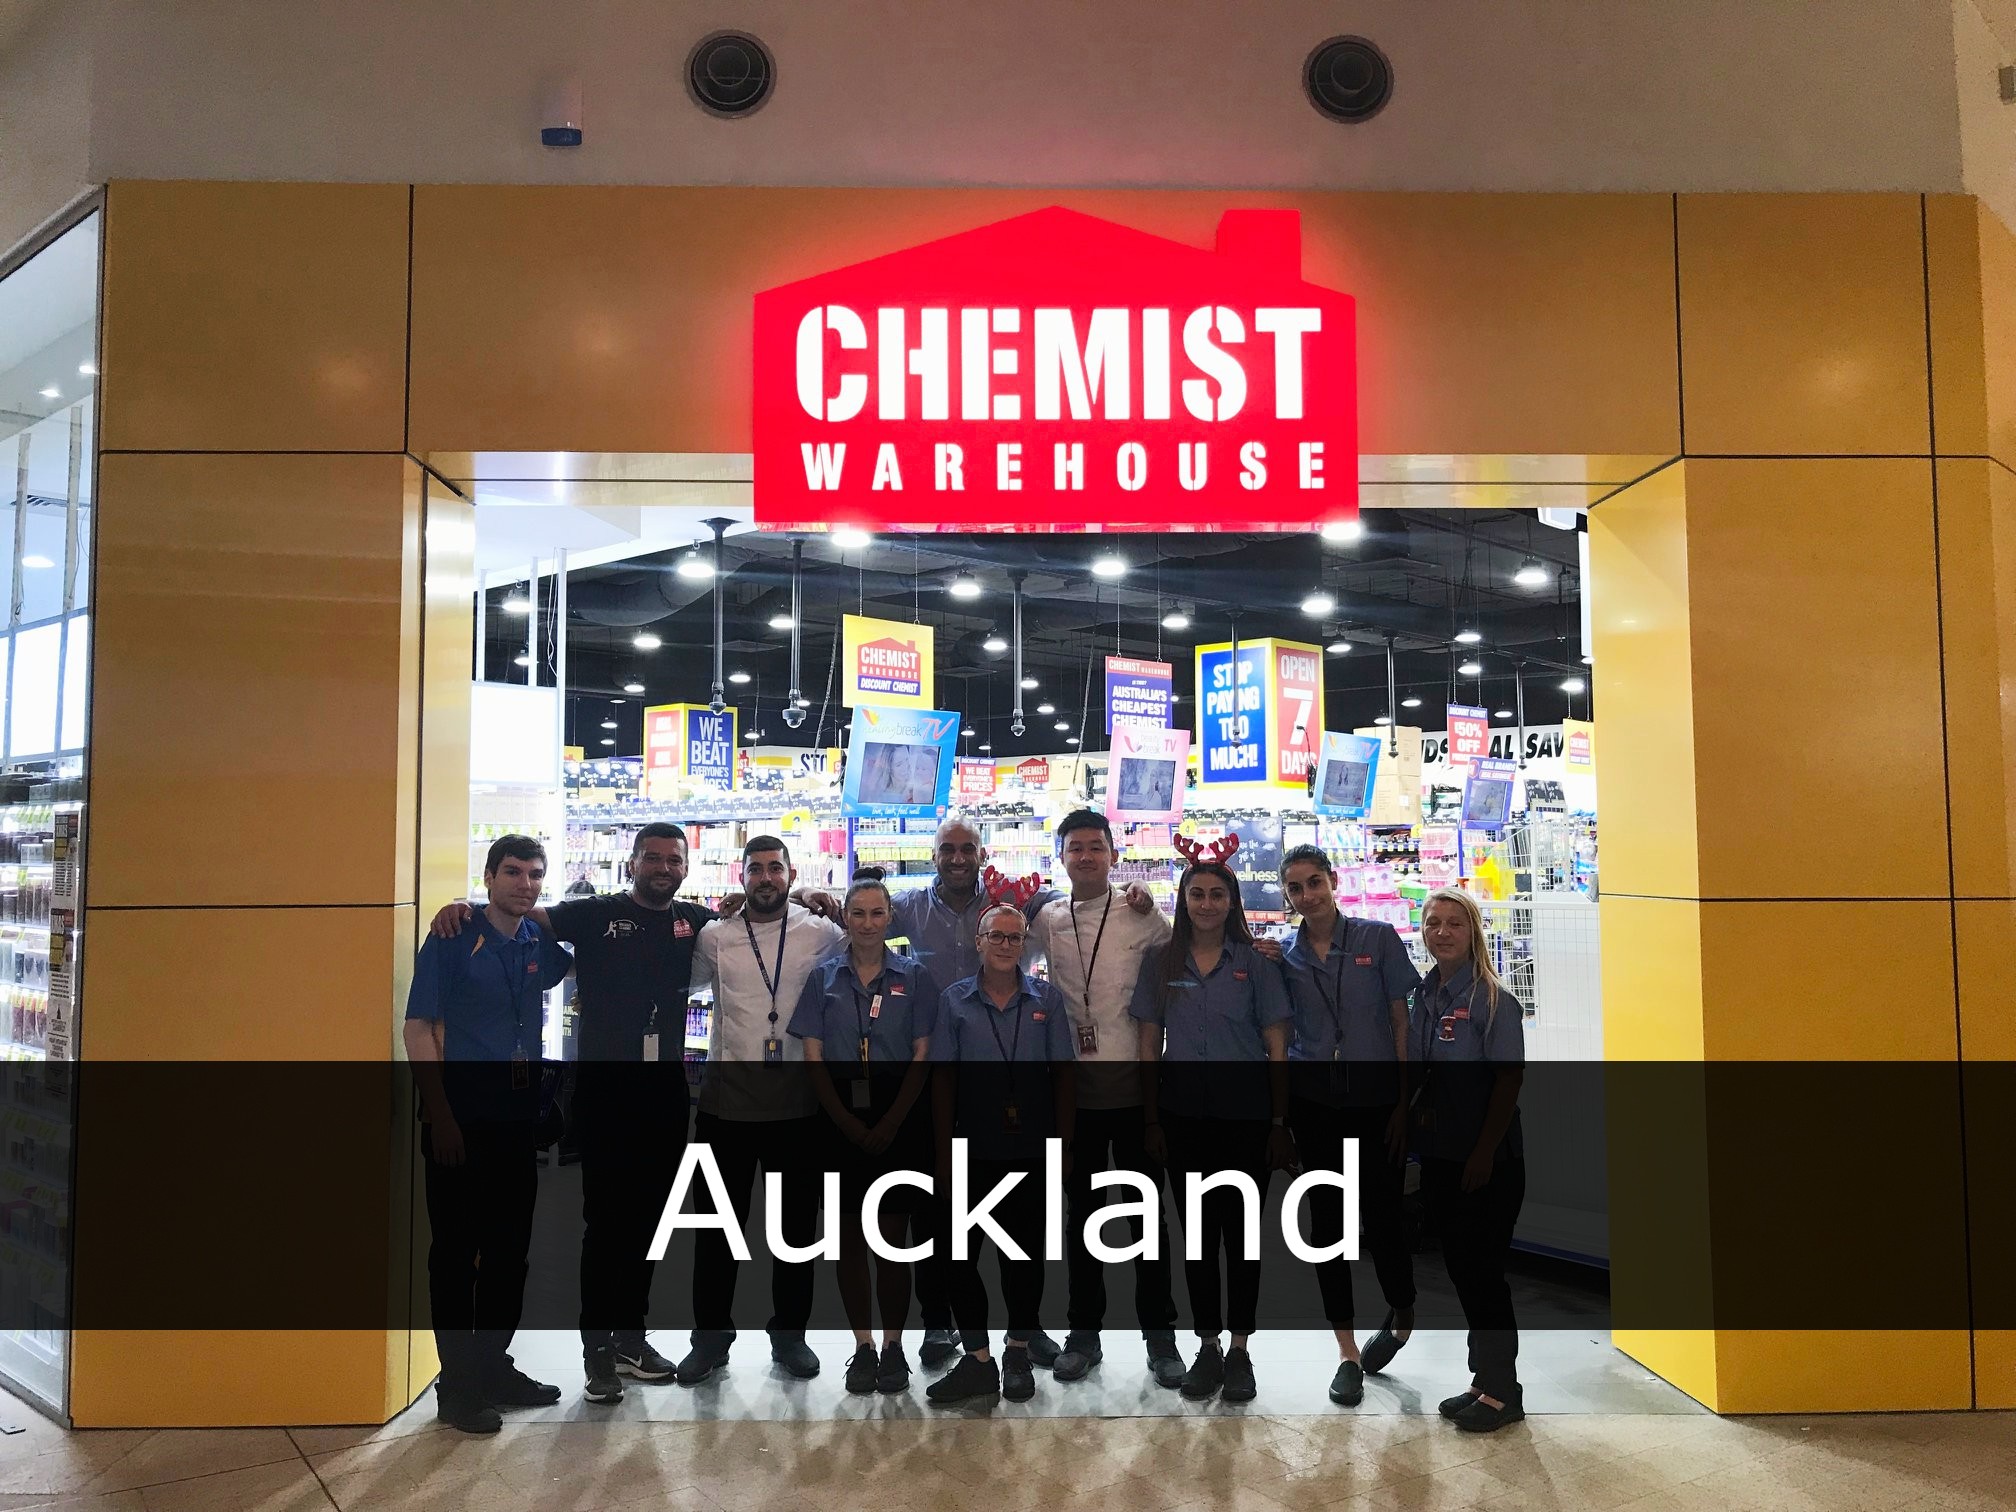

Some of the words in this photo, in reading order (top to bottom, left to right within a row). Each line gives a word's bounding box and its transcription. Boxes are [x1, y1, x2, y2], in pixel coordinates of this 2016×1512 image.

[796, 305, 1321, 422] CHEMIST
[801, 442, 1325, 491] WAREHOUSE
[861, 646, 917, 669] CHEMIST
[1109, 659, 1141, 673] CHEMIST
[861, 666, 918, 679] WAREHOUSE
[1281, 655, 1315, 682] OPEN
[860, 678, 892, 691] DISCOUNT
[892, 682, 918, 693] CHEMIST
[1112, 685, 1167, 702] AUSTRALIA'S
[1207, 686, 1260, 715] PAYNG
[1112, 699, 1167, 716] CHEAPEST
[1283, 687, 1313, 745] 7
[699, 717, 723, 741] WE
[922, 718, 956, 740] TV
[1112, 714, 1167, 728] CHEMIST
[691, 740, 729, 765] BEAT
[1165, 739, 1177, 752] TV
[1456, 738, 1480, 752] OFF
[1210, 744, 1258, 771] MUCH!
[691, 765, 729, 777] EVERYONE'S
[965, 767, 975, 775] WE
[1019, 765, 1047, 775] CHEMIST
[1235, 863, 1278, 881] wellness
